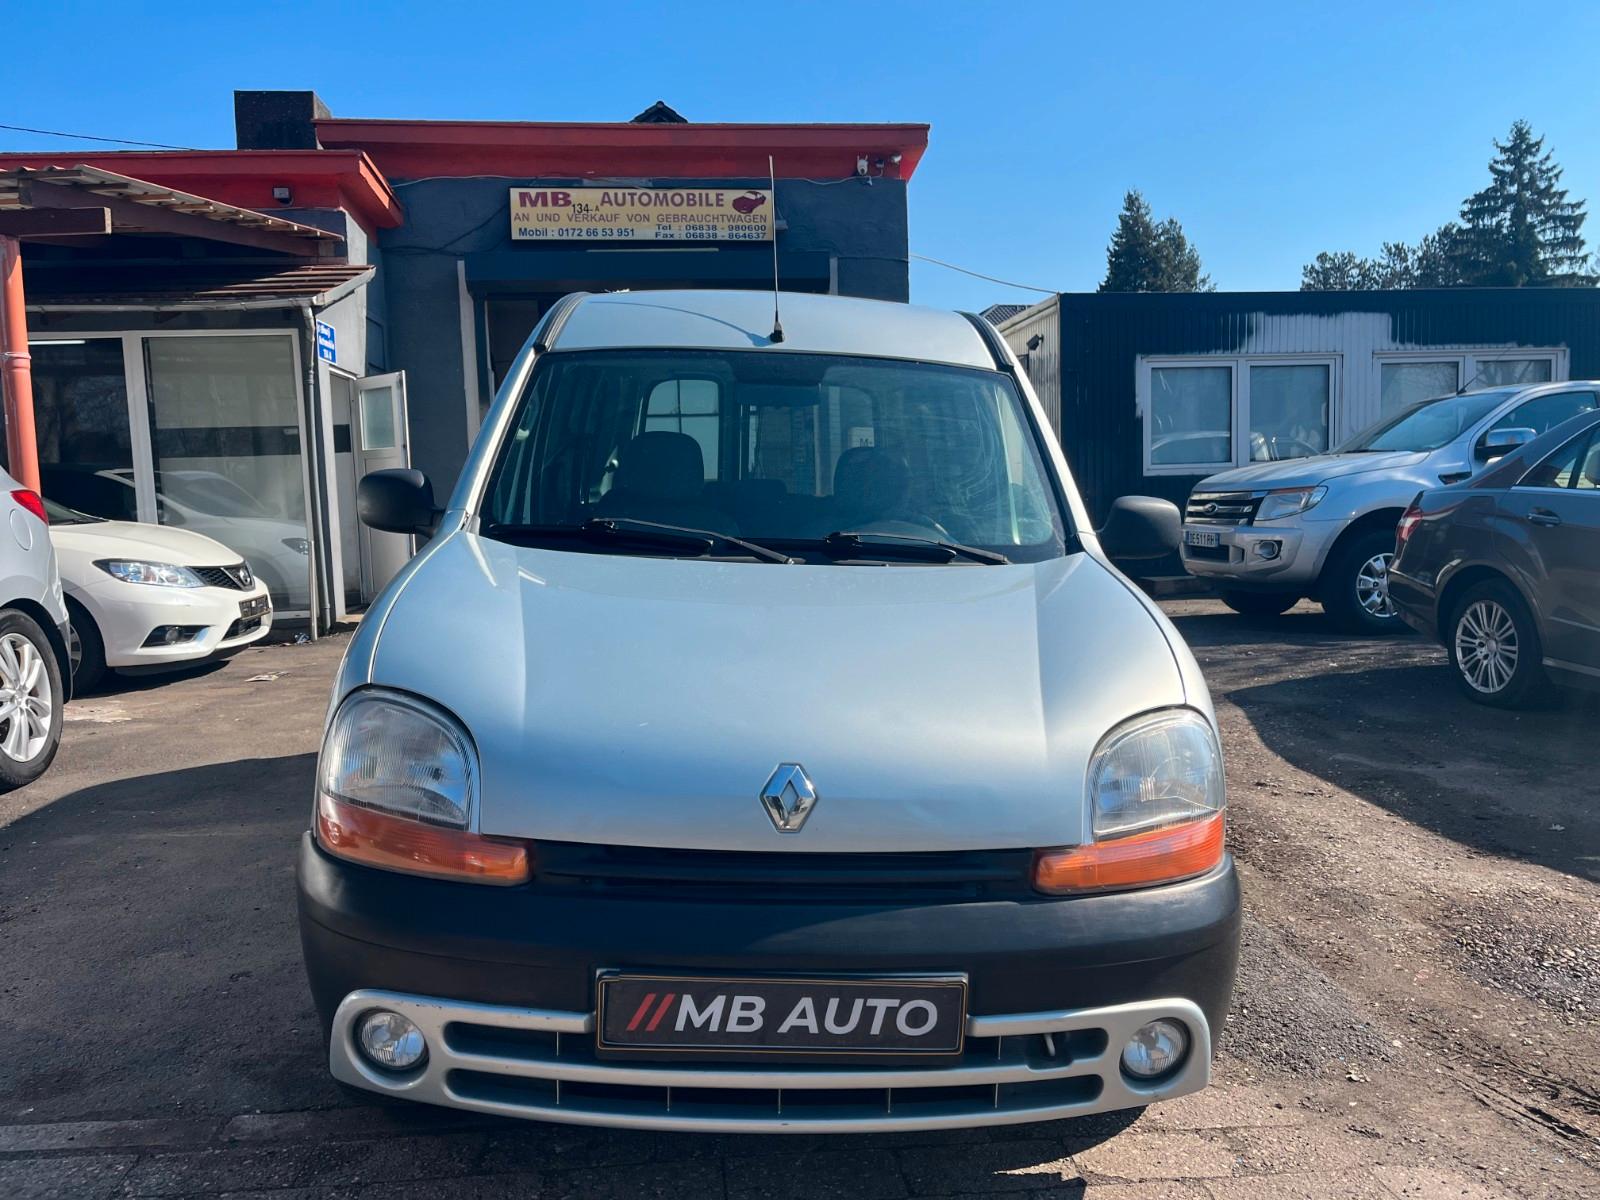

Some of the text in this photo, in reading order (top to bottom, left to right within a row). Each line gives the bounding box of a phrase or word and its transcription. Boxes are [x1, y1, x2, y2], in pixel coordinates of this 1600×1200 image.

[518, 191, 725, 208] MB AUTOMOBILE
[513, 213, 767, 223] AN UND VERKAUF VON GEBRAUCHTWAGEN
[518, 227, 548, 237] Mobil
[558, 227, 583, 237] 0172
[586, 227, 599, 237] 66
[601, 228, 614, 237] 53
[617, 228, 635, 237] 951
[776, 997, 938, 1037] AUTO
